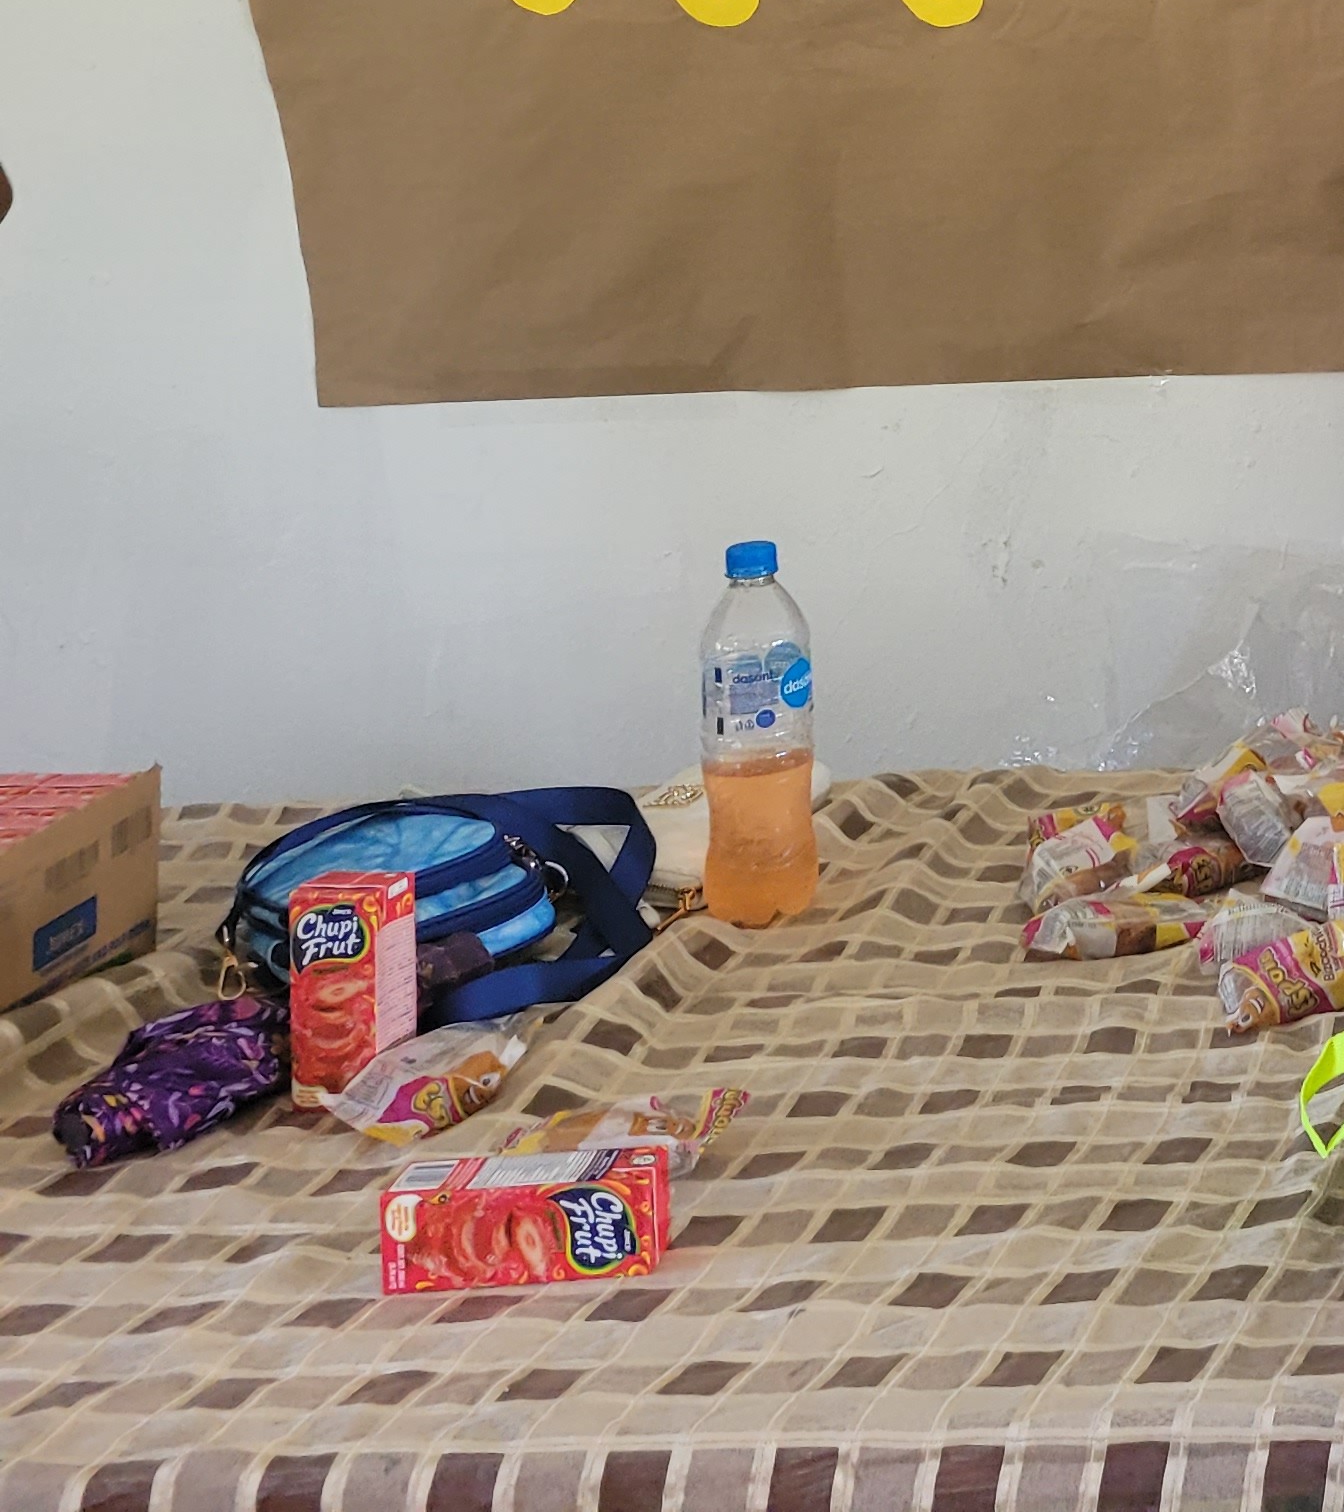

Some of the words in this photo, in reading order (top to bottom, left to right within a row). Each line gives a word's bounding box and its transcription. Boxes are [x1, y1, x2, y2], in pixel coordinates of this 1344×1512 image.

[296, 912, 358, 940] Chupi
[301, 933, 361, 966] Frut
[559, 1197, 602, 1264] Frut
[590, 1191, 623, 1261] Chupi
